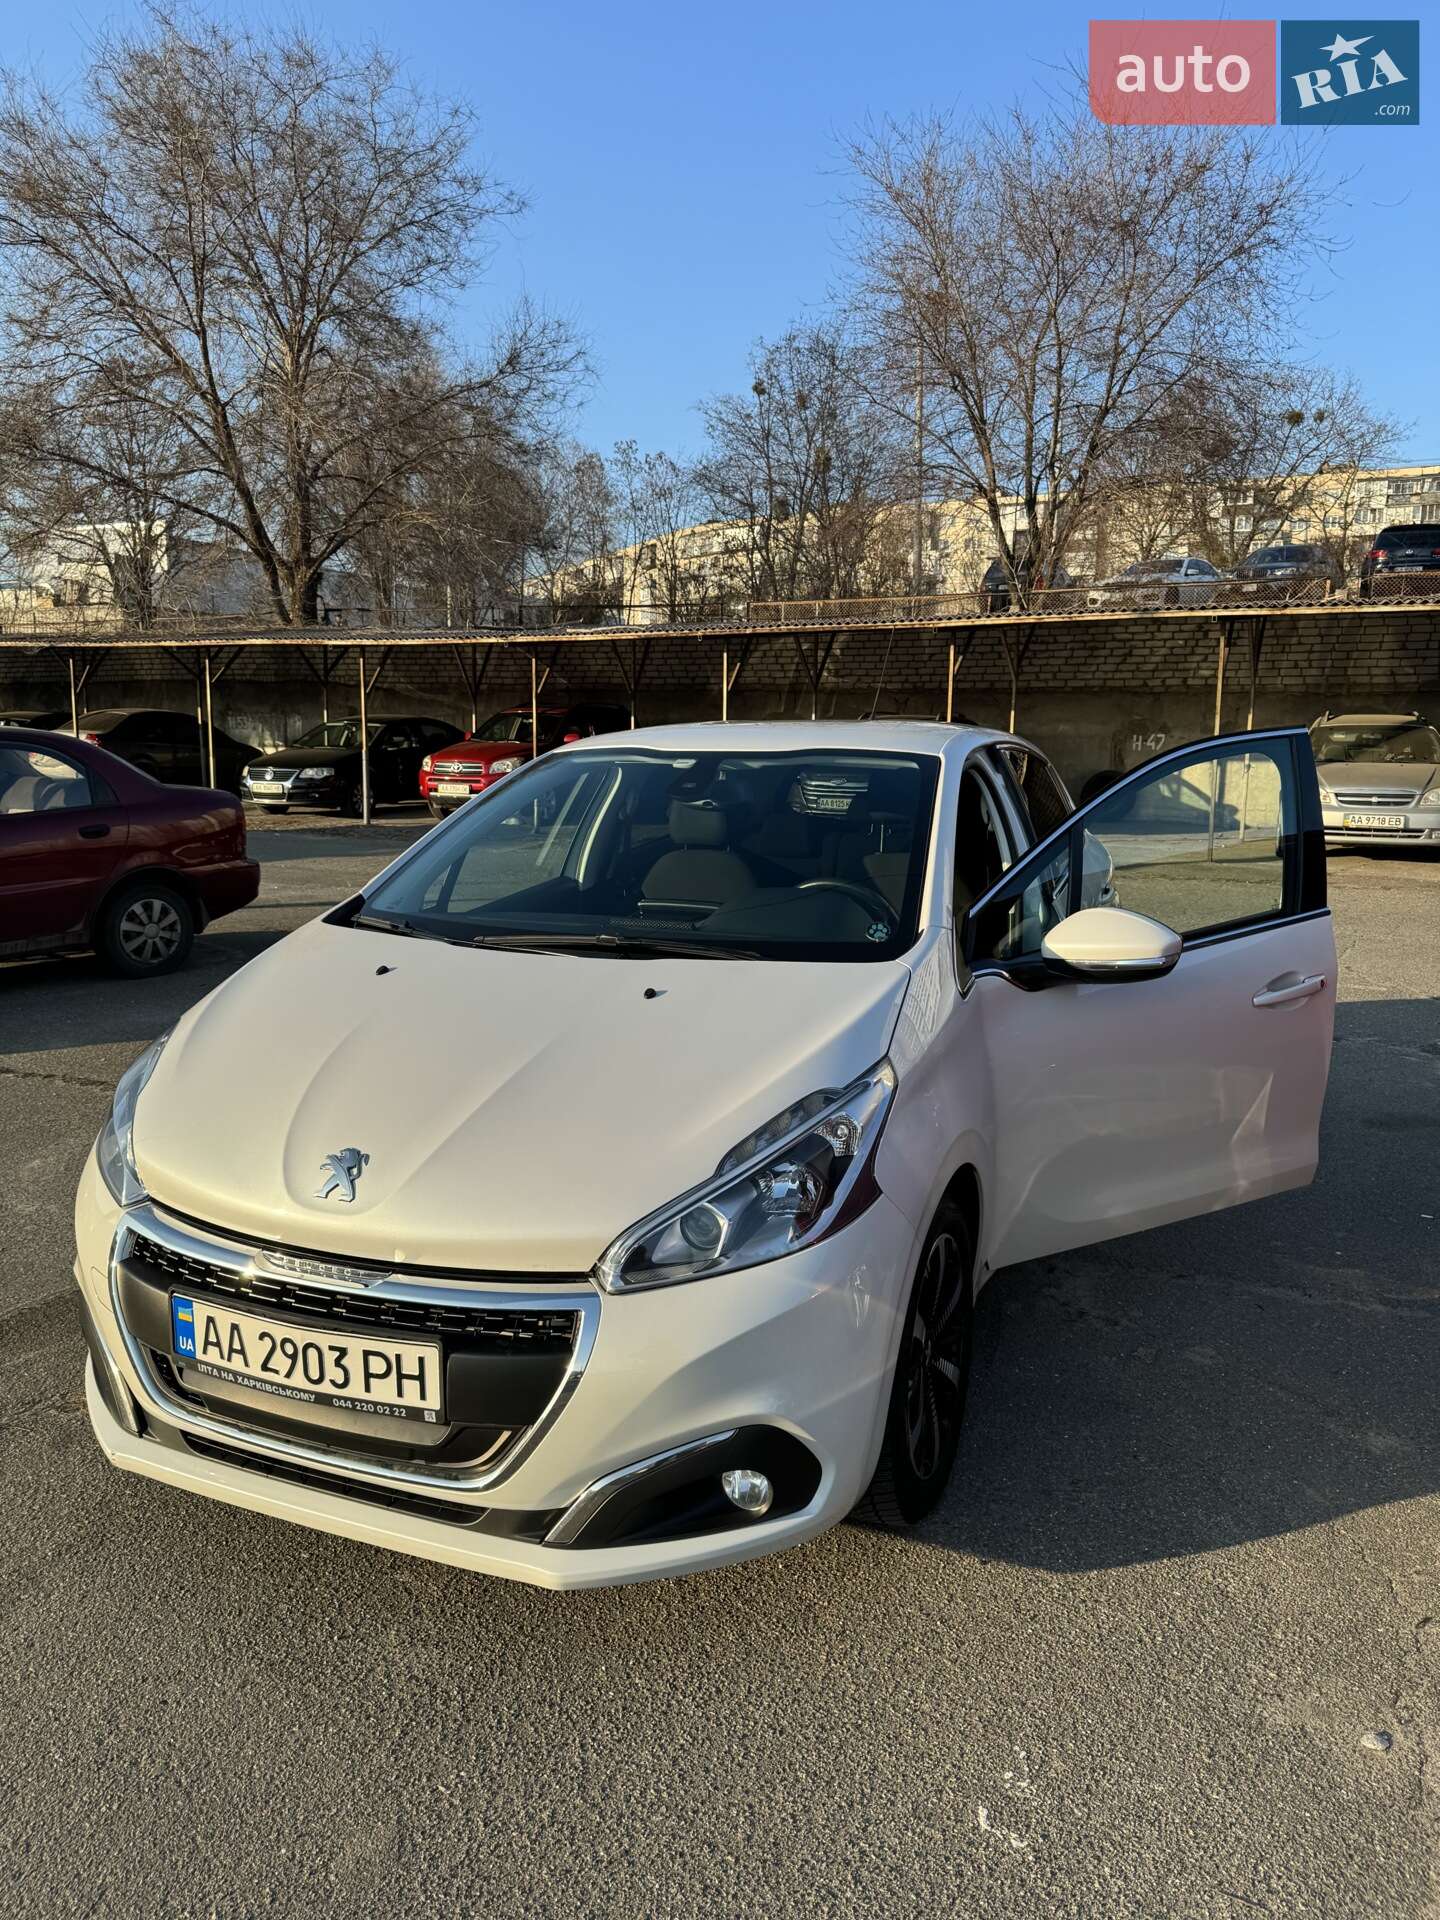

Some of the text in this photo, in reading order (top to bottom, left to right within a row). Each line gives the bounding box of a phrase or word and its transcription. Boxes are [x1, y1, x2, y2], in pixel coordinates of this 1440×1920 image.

[1350, 815, 1363, 825] AA
[1365, 816, 1386, 825] 9718
[179, 1335, 194, 1352] UA
[202, 1314, 427, 1402] AA 2903 PH
[220, 1370, 235, 1382] НА
[236, 1375, 316, 1402] ХАРКІВСЬКОМУ
[332, 1398, 407, 1417] 044 220 02 22
